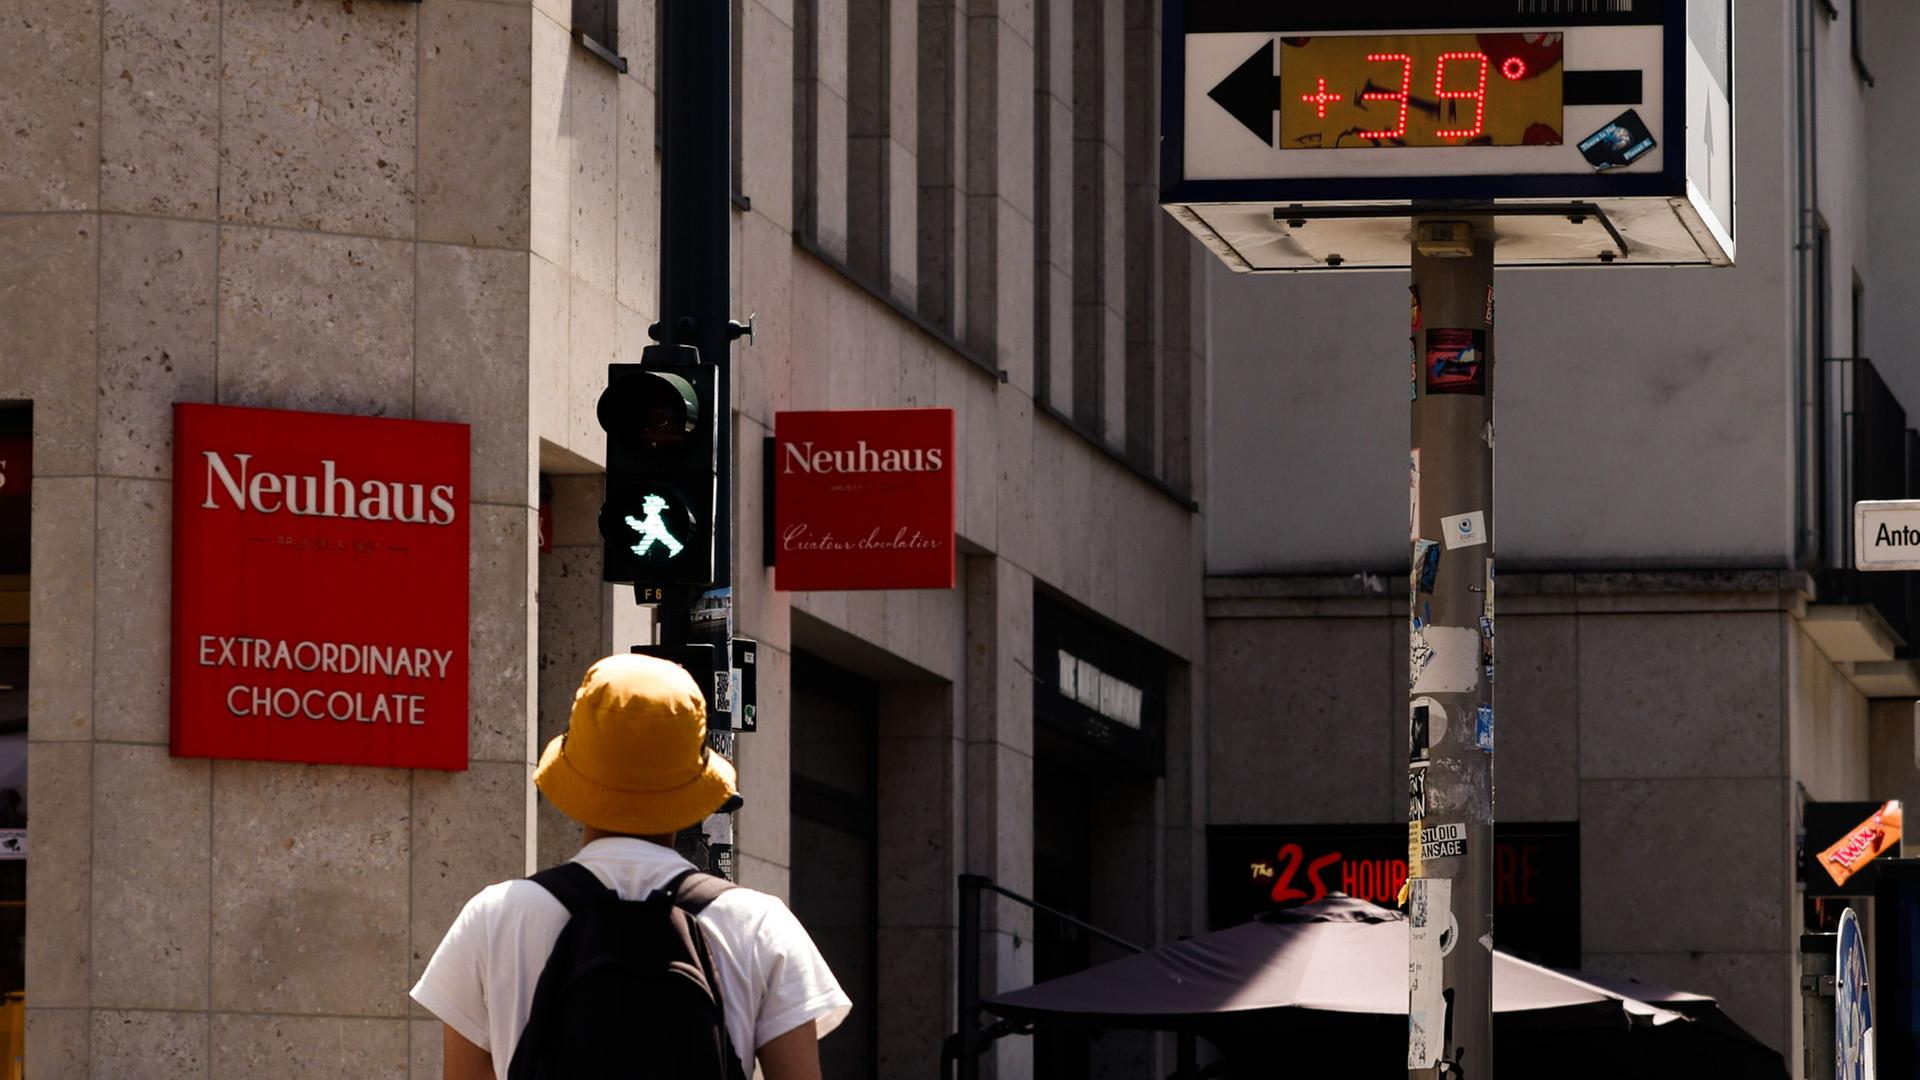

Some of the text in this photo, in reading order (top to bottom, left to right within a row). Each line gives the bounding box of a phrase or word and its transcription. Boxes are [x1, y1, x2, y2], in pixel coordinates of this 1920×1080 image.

[783, 440, 943, 474] Neuhaus
[202, 451, 456, 526] Neuhaus
[858, 526, 943, 550] chocolatier
[1875, 522, 1920, 546] Anto
[645, 587, 662, 600] F 6
[199, 635, 454, 679] EXTRAORDINARY
[226, 685, 426, 725] CHOCOLATE
[1421, 825, 1458, 843] STUDIO
[1421, 841, 1462, 860] ANSAGE
[1251, 863, 1274, 879] The
[1271, 843, 1342, 905] 25
